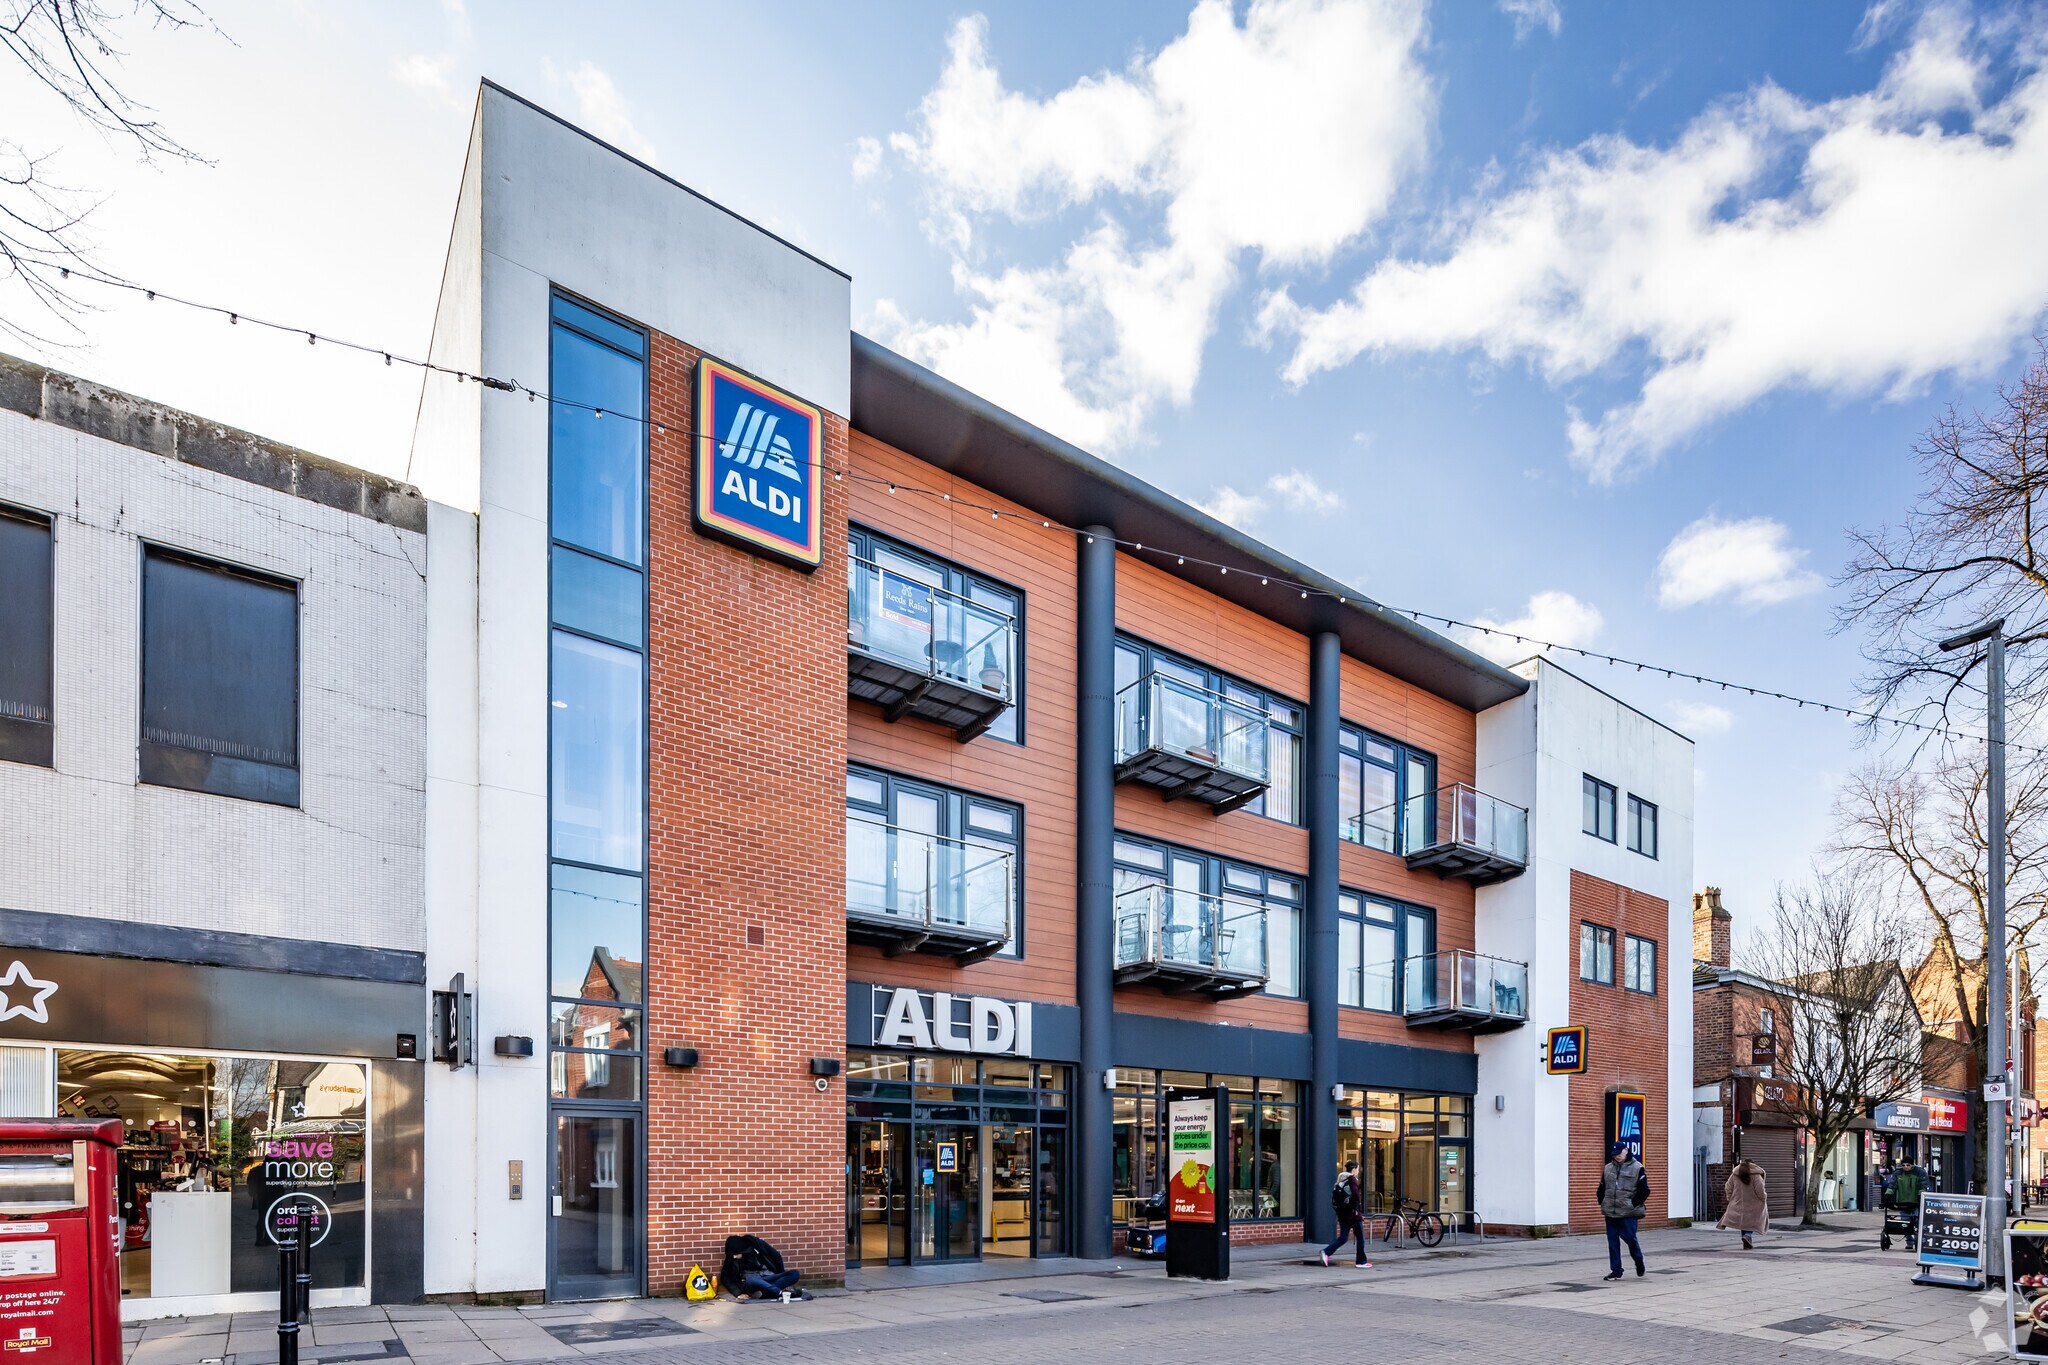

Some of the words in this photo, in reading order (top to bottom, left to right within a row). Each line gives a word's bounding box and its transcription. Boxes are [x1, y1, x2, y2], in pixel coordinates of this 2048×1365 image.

[722, 469, 801, 524] ALDI
[886, 590, 907, 606] Reeds
[908, 599, 928, 614] Rains
[877, 988, 1032, 1059] ALDI
[1553, 1054, 1577, 1064] ALDI
[1174, 1114, 1193, 1123] Always
[1194, 1114, 1208, 1122] keep
[1886, 1115, 1920, 1129] AMUSEMENTS
[1174, 1132, 1191, 1140] prices
[267, 1141, 334, 1159] save
[1183, 1141, 1197, 1149] price
[265, 1161, 334, 1178] more
[311, 1205, 319, 1215] &
[1174, 1203, 1196, 1213] next
[1925, 1200, 1951, 1208] Travel
[1951, 1202, 1979, 1211] Money
[1938, 1209, 1978, 1217] Commission
[276, 1215, 320, 1225] collt
[5, 1292, 37, 1300] postage
[0, 1301, 11, 1309] rop
[1, 1309, 54, 1319] royalmail.com
[7, 1340, 30, 1349] Royal
[31, 1338, 49, 1346] Mail
